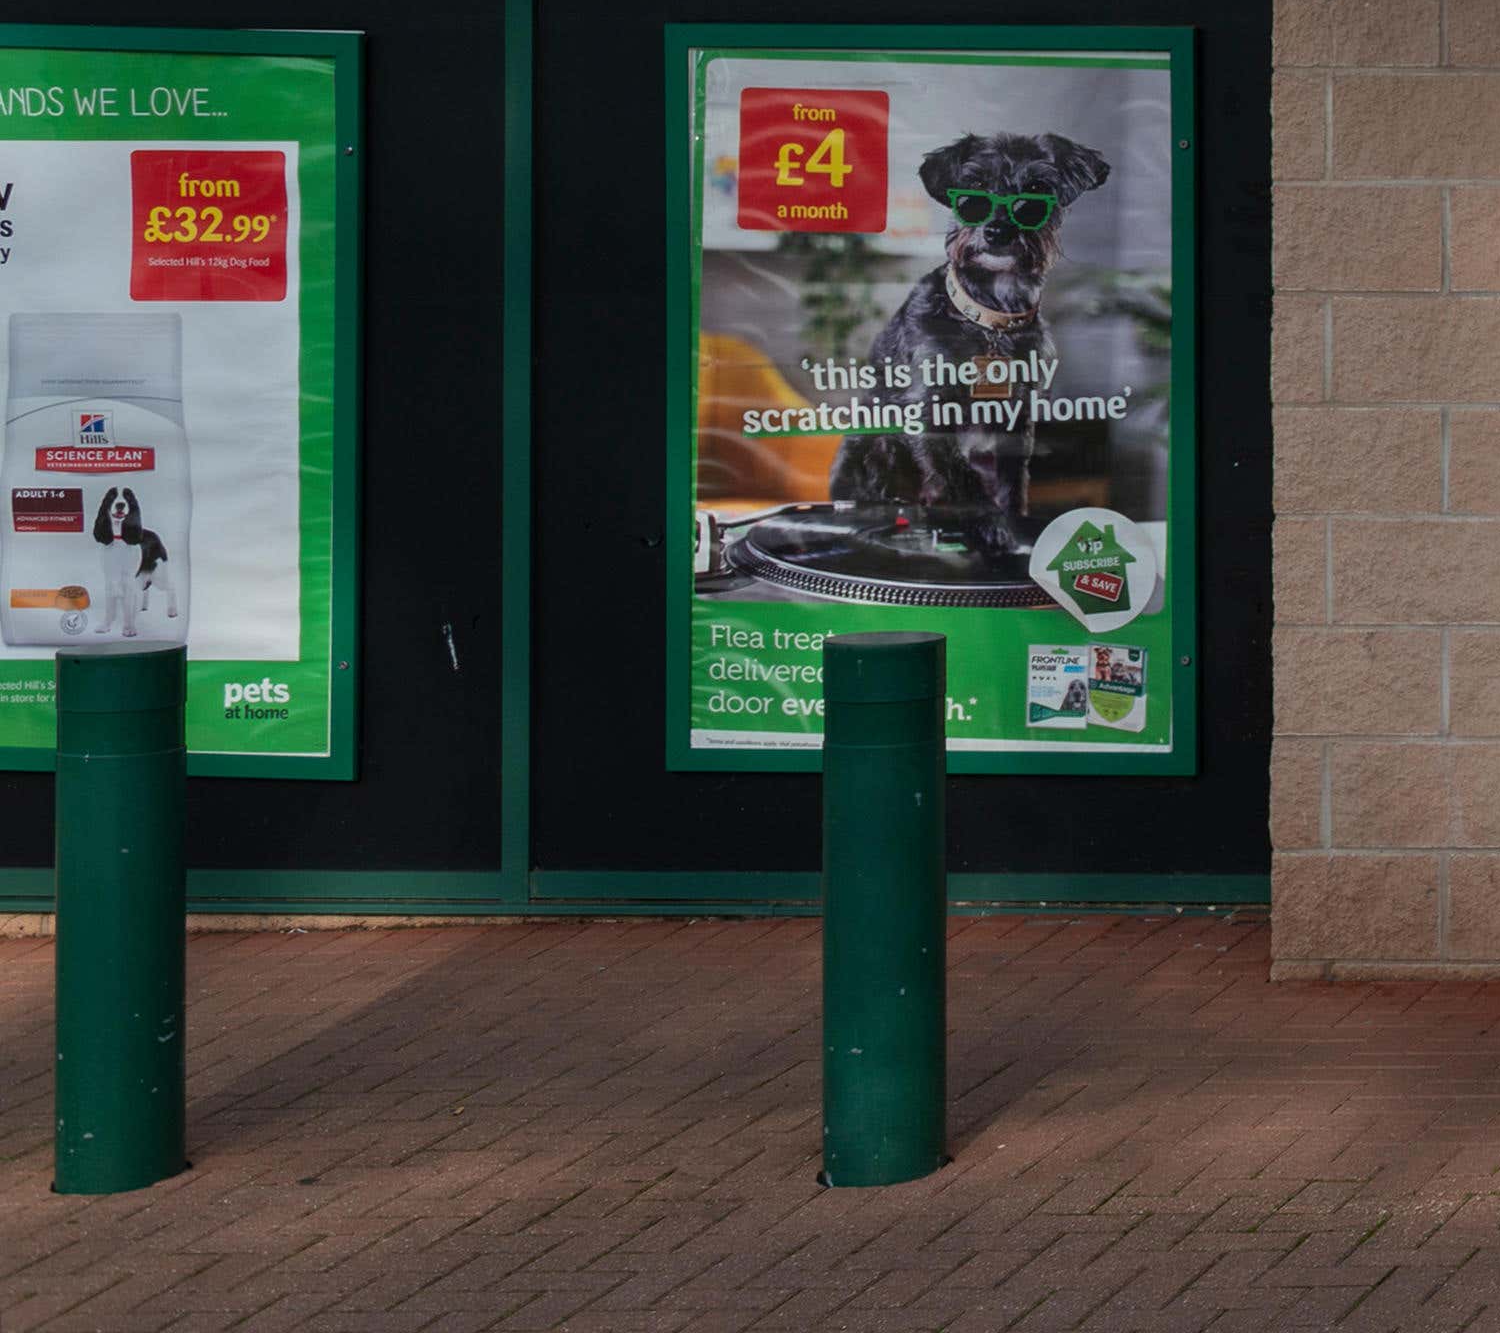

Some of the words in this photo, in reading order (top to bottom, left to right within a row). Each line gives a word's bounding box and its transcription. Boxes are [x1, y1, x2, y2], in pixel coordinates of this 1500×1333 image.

[74, 87, 119, 117] WE
[131, 86, 228, 117] LOVE...
[792, 103, 836, 122] from
[774, 128, 853, 188] £4
[179, 172, 241, 198] from
[777, 204, 788, 219] a
[790, 202, 849, 220] month
[148, 256, 185, 267] Selected
[208, 256, 229, 269] 12kg
[230, 257, 247, 269] Dog
[248, 257, 270, 268] Food
[884, 356, 912, 389] is
[919, 353, 979, 386] the
[986, 349, 1059, 390] only
[742, 396, 925, 435] scratching
[932, 394, 963, 426] in
[971, 399, 1023, 432] my
[46, 450, 104, 461] SCIENCE
[16, 490, 47, 499] ADULT
[50, 490, 65, 499] 1-6
[1062, 555, 1121, 572] SUBSCRIBE
[1080, 574, 1090, 585] &
[1091, 576, 1117, 594] SAVE
[710, 624, 765, 649] Flea
[223, 677, 290, 707] pets
[708, 690, 774, 714] door
[781, 696, 825, 716] eve
[225, 705, 240, 720] at
[244, 703, 289, 721] home
